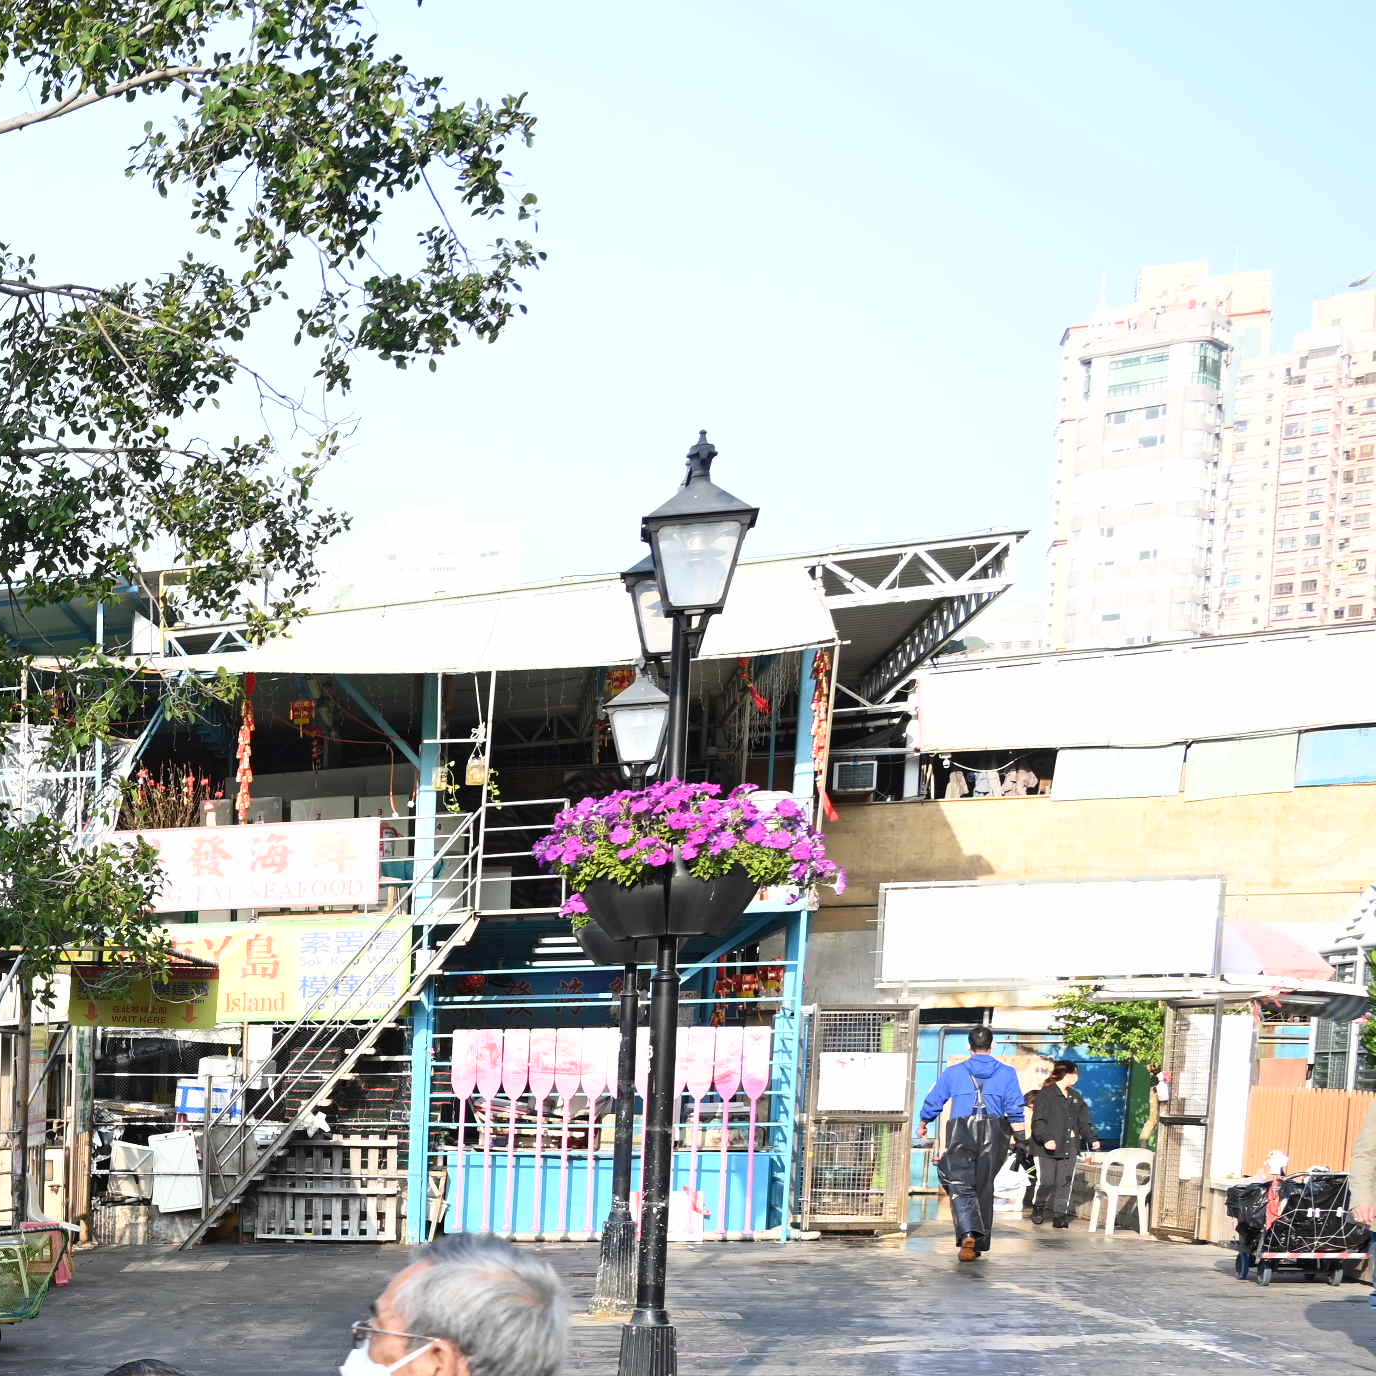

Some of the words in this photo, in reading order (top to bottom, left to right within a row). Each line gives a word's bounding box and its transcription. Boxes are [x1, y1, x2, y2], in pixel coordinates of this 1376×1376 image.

[223, 991, 286, 1013] Island
[111, 1015, 137, 1024] WAIT
[139, 1015, 167, 1025] HERE
